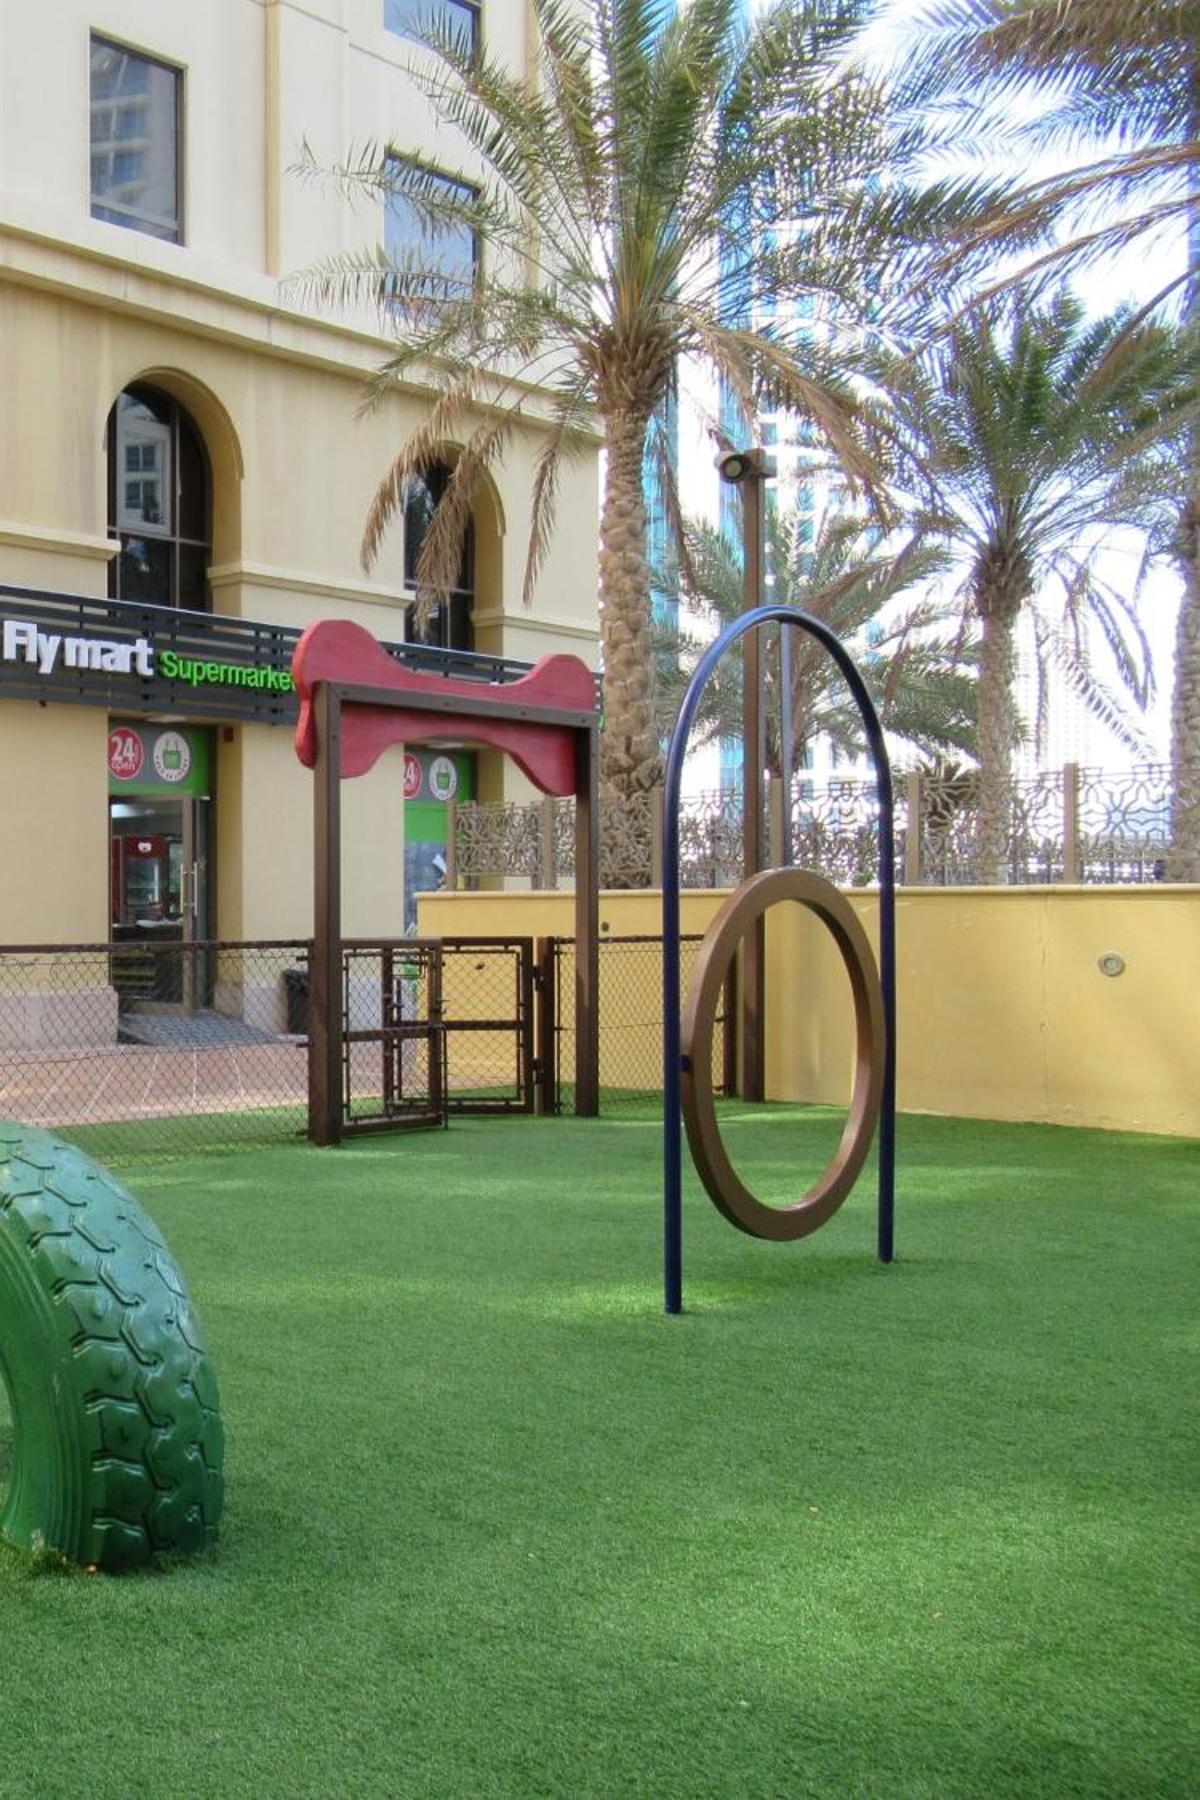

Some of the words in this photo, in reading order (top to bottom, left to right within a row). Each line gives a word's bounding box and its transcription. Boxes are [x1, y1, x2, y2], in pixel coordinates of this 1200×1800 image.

[3, 620, 61, 674] Fly
[64, 636, 154, 676] mart
[111, 735, 135, 762] 24
